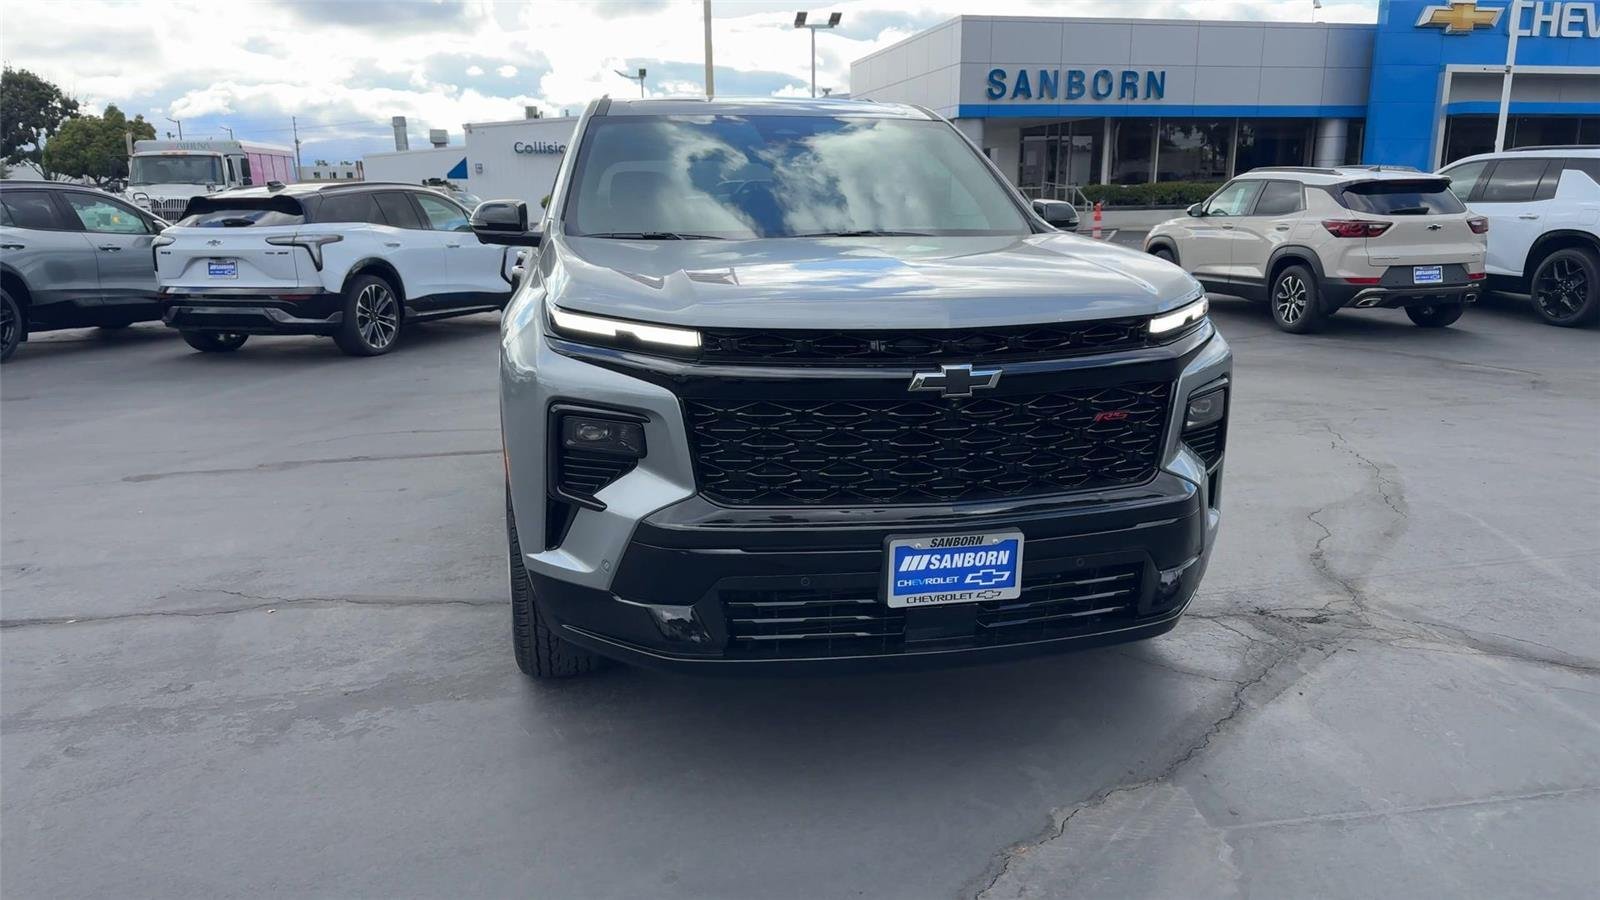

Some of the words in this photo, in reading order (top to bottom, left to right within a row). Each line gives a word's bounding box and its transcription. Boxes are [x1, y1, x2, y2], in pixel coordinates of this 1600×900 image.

[986, 68, 1166, 100] SANBORN
[930, 535, 984, 548] SANBORN
[929, 550, 1010, 570] SANBORN
[897, 576, 959, 588] CHEVROLET
[906, 591, 973, 604] CHEVROLET
